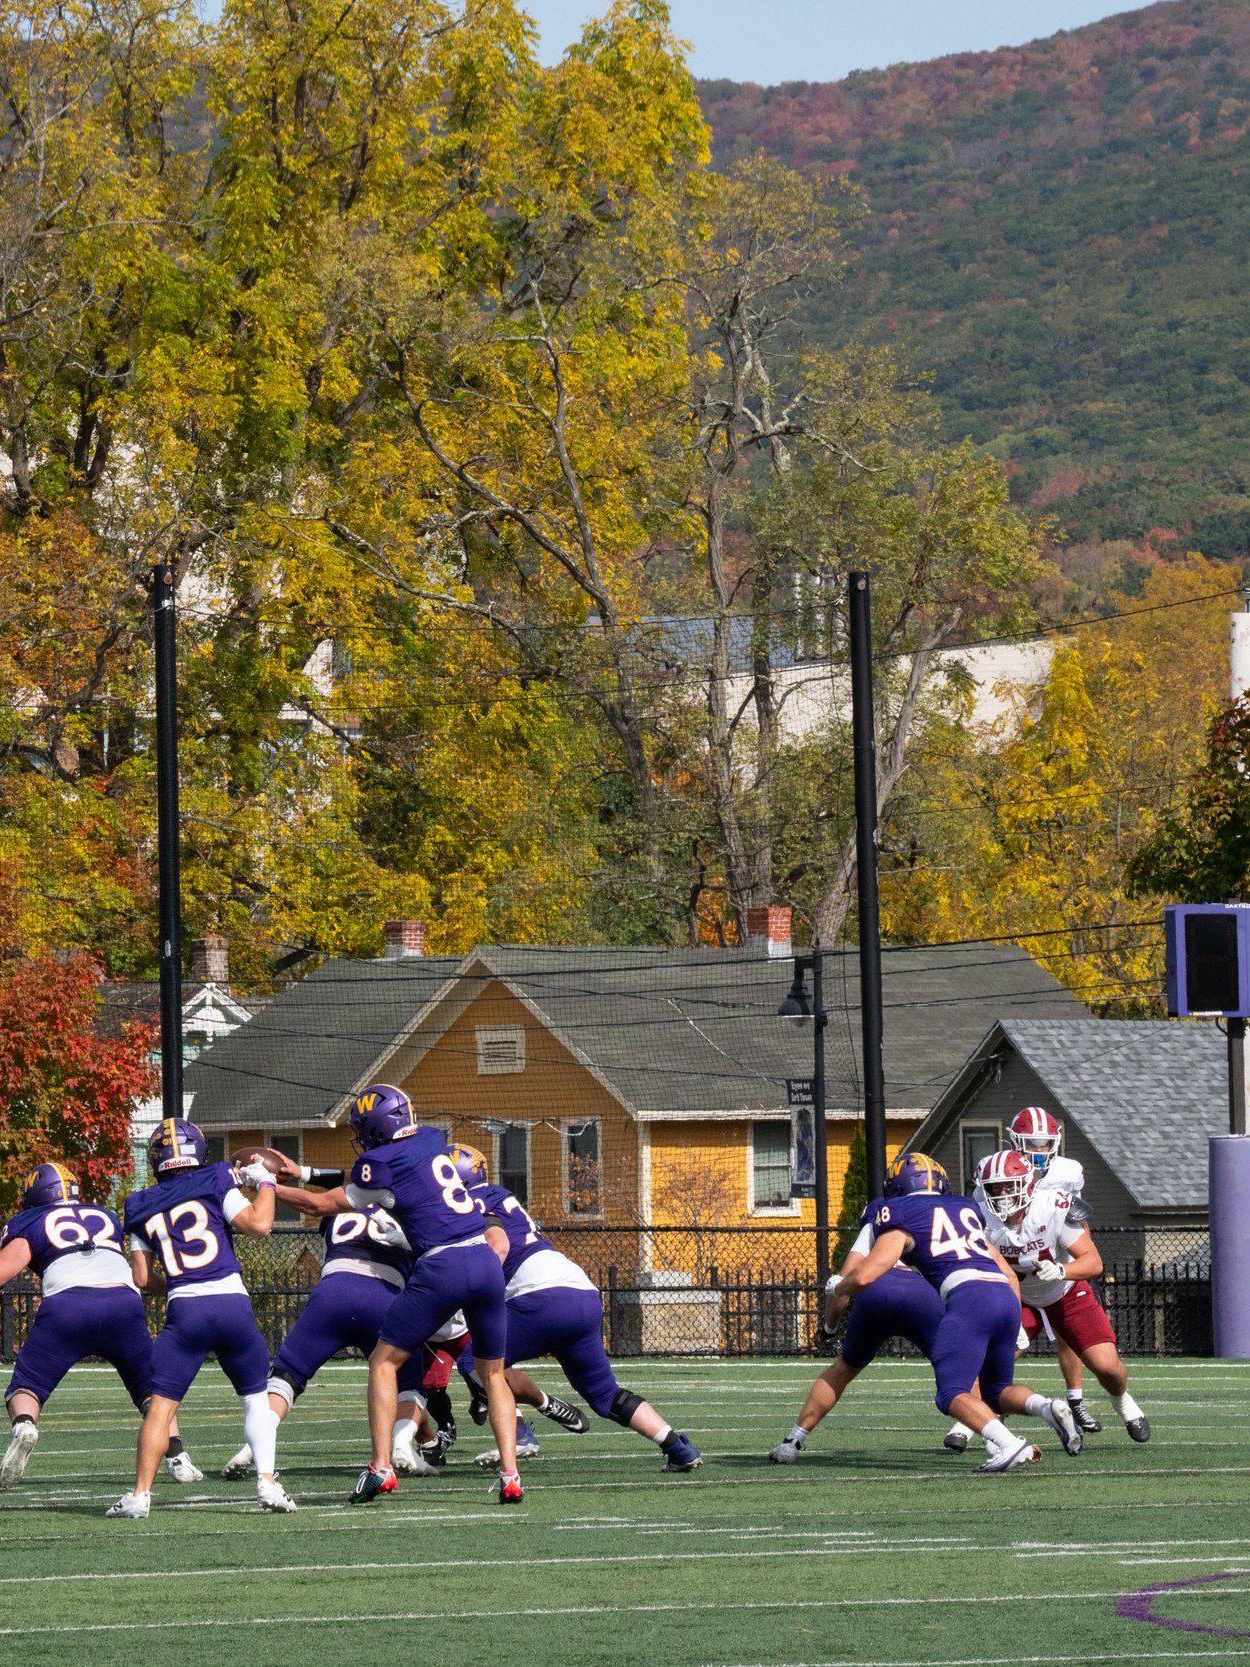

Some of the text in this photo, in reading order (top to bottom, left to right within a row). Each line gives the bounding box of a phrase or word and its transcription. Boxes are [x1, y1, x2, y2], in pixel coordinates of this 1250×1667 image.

[357, 1093, 377, 1115] W
[164, 1159, 192, 1169] Riddell
[361, 1164, 372, 1182] 8
[432, 1153, 474, 1214] 8
[45, 1207, 123, 1250] 62
[145, 1200, 219, 1277] 13
[930, 1207, 994, 1260] 48
[1000, 1239, 1045, 1256] BOBCATS
